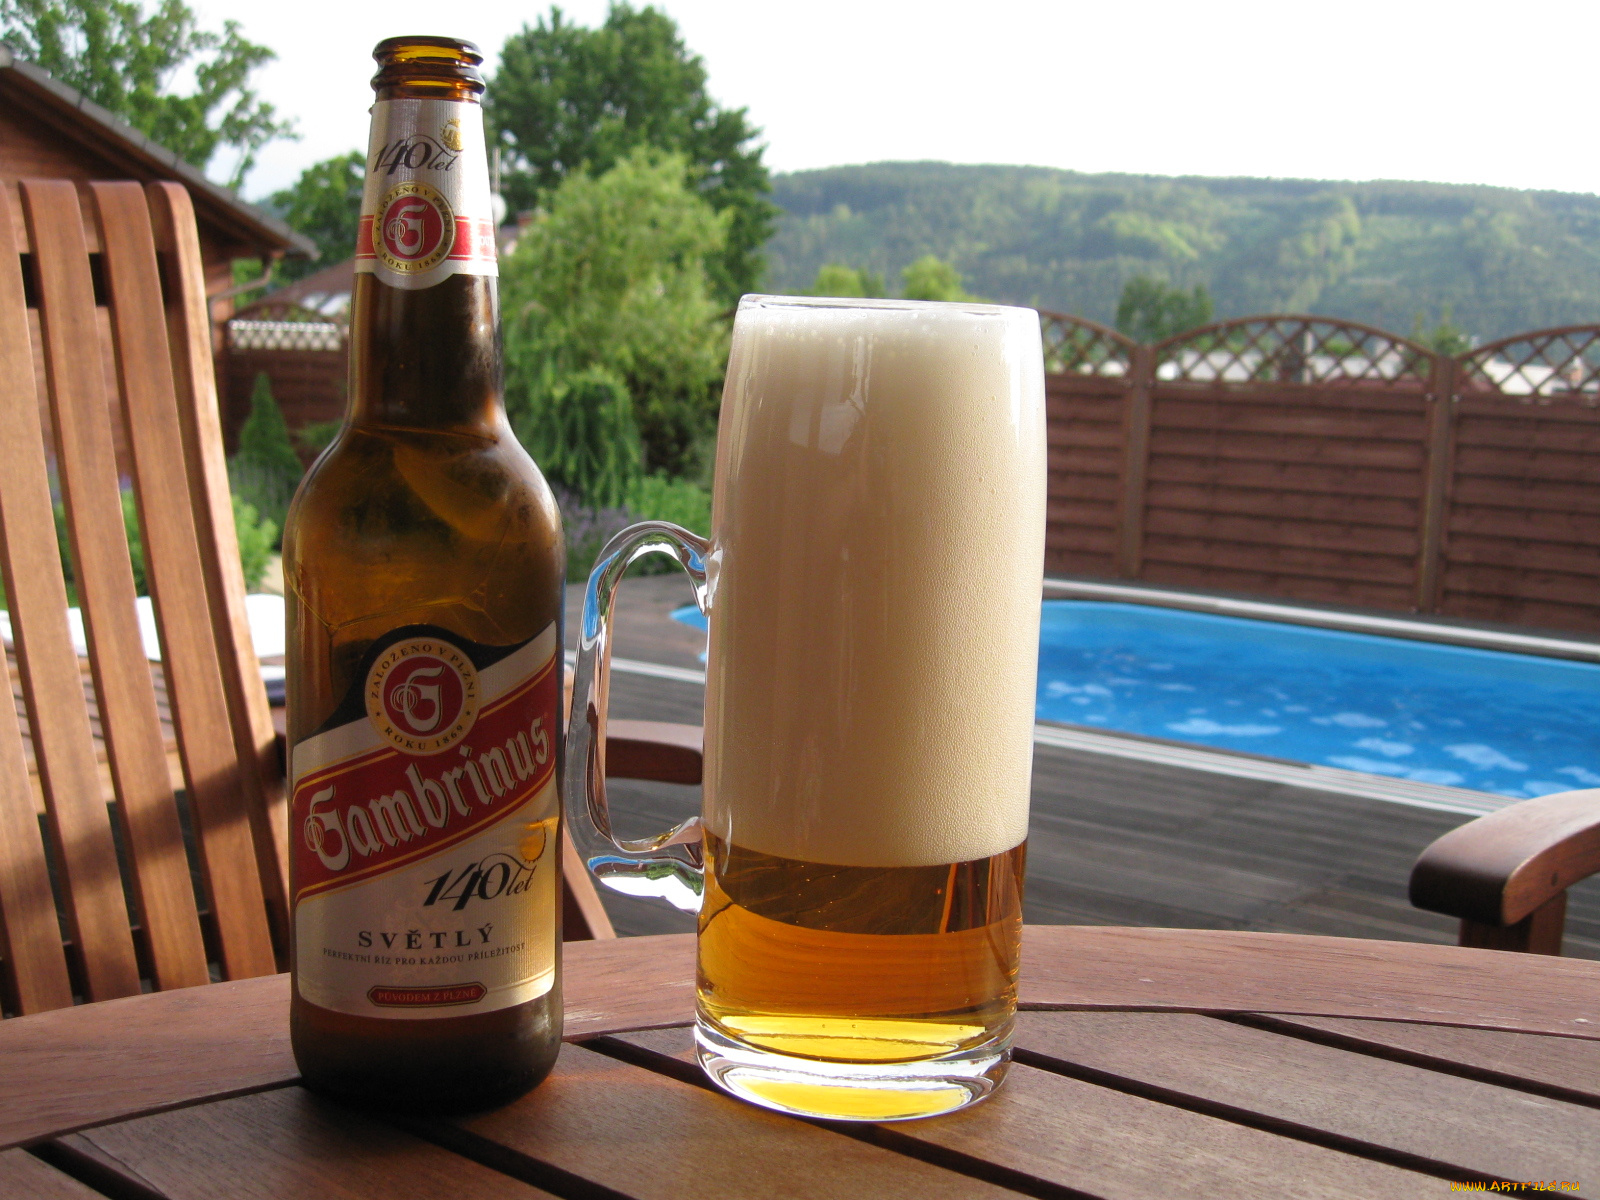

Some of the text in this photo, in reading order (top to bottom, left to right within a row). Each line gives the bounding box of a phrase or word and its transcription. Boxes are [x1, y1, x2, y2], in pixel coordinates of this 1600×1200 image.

[382, 252, 442, 270] ROKU 1869
[371, 644, 475, 699] ZALOŽENO V PLZNI
[384, 725, 463, 750] ROKU 1869
[304, 717, 549, 871] Gambrinus
[358, 923, 494, 950] SVĚTLÝ
[323, 948, 371, 963] PERFEKTNÍ
[395, 957, 416, 965] PRO
[420, 955, 464, 965] KAŽDOU
[433, 992, 440, 1001] Z
